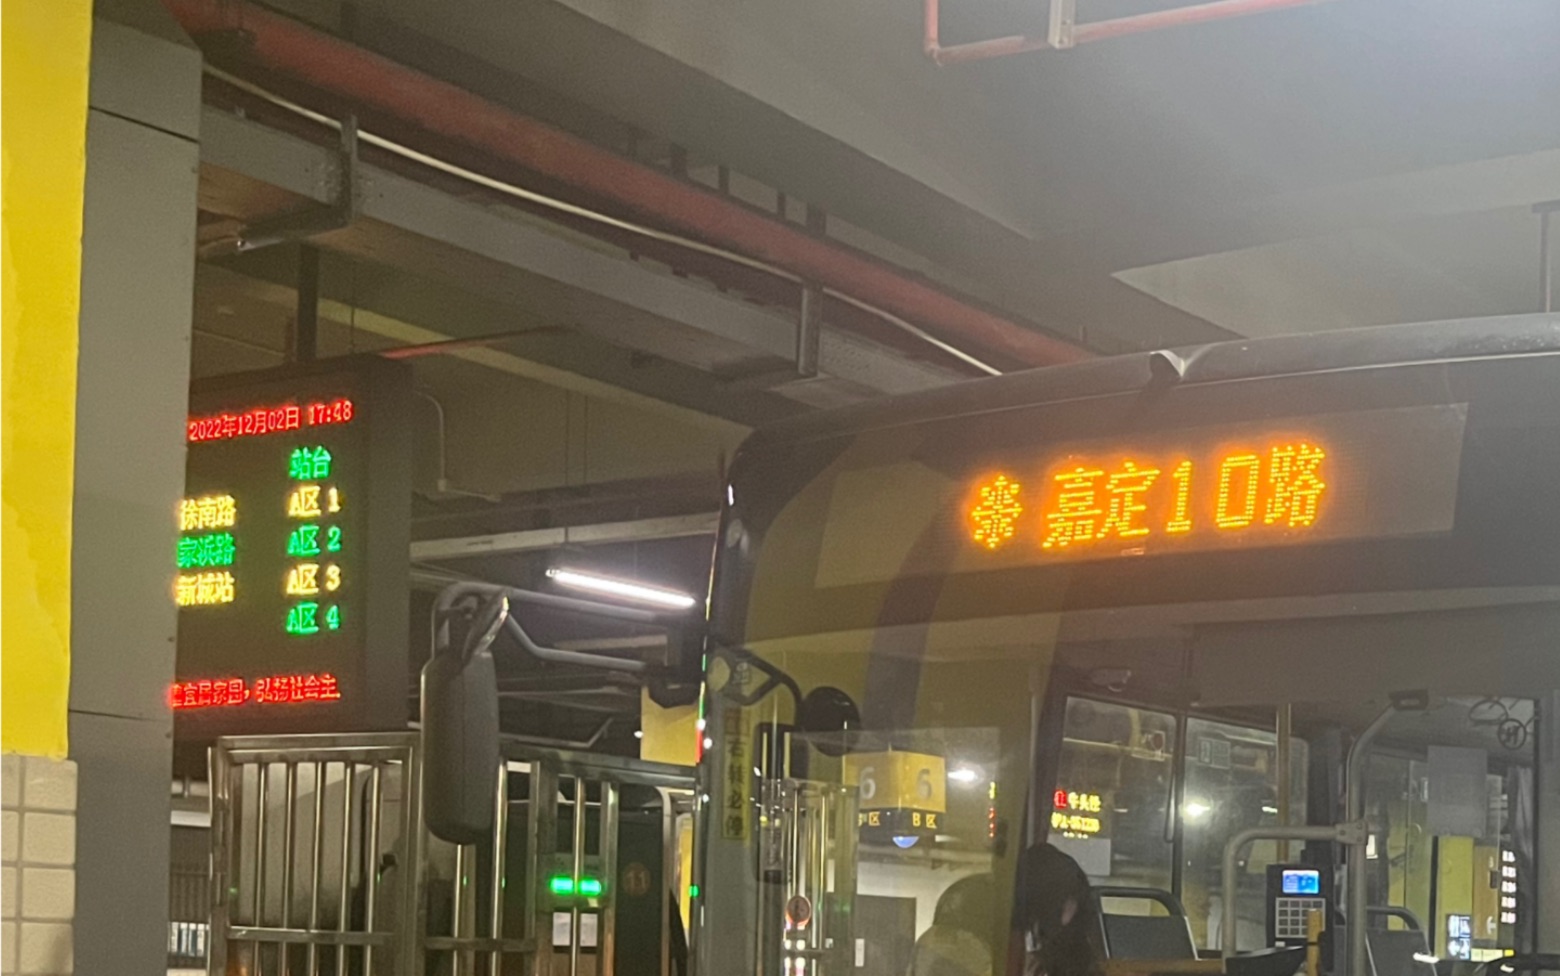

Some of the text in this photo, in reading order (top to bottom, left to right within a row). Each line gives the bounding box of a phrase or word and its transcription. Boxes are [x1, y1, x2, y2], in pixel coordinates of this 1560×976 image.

[189, 401, 352, 441] 2022年12月02日 17:48
[289, 446, 332, 479] 站台
